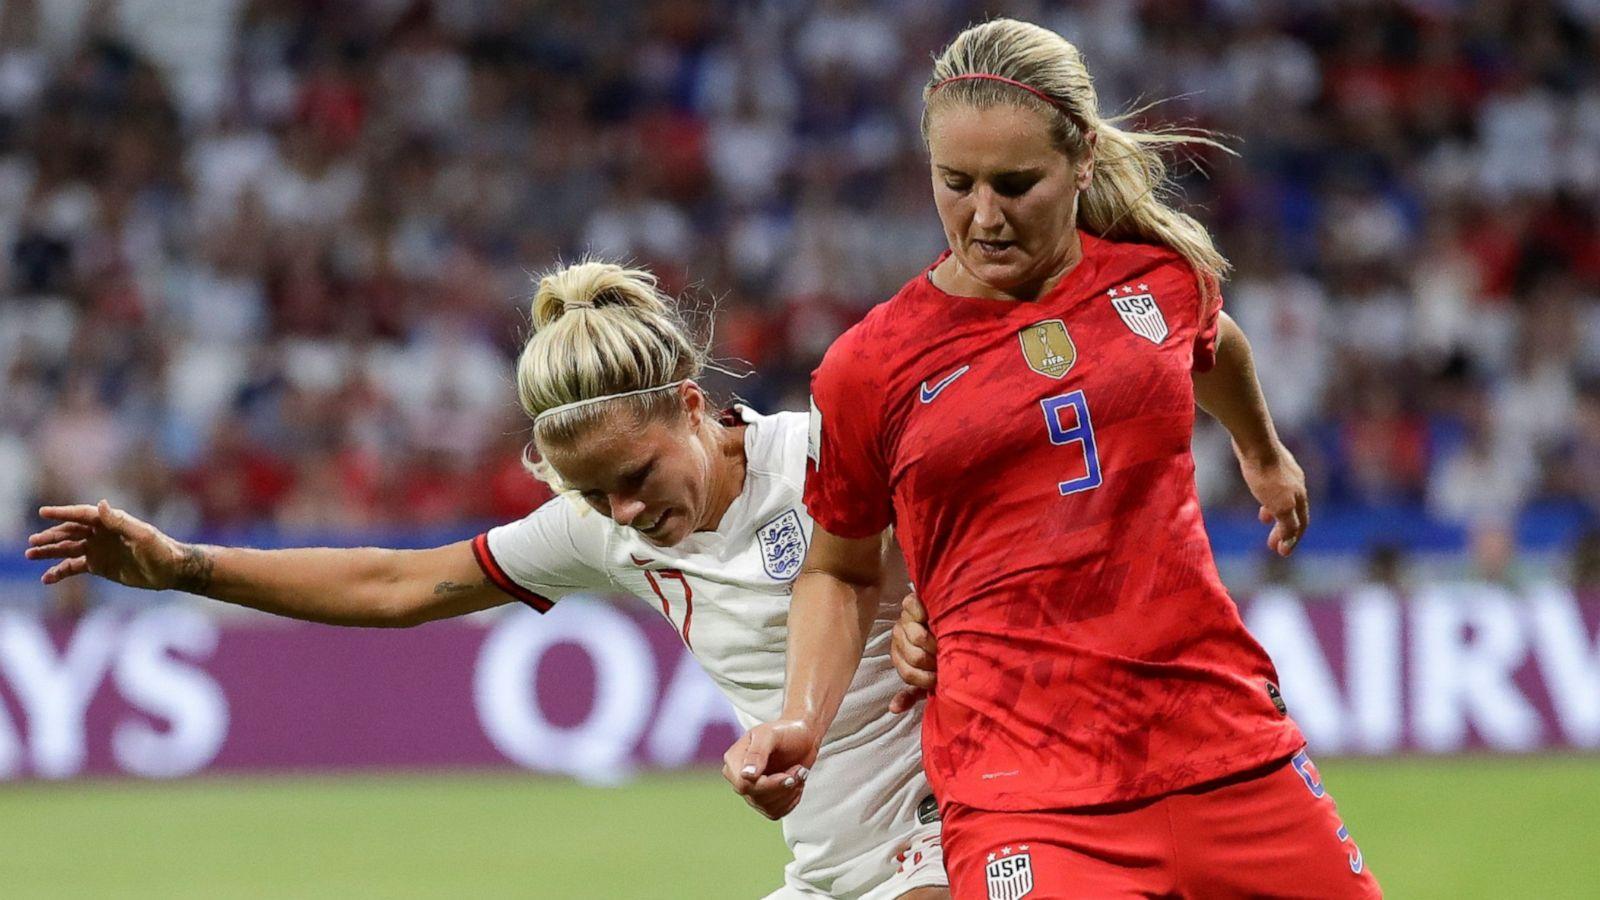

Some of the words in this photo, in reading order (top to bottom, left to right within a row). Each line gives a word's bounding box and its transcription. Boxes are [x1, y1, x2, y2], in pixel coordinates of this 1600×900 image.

[1115, 297, 1154, 315] USA
[1042, 355, 1065, 366] FIFA
[1040, 389, 1103, 496] 9
[988, 857, 1026, 878] USA
